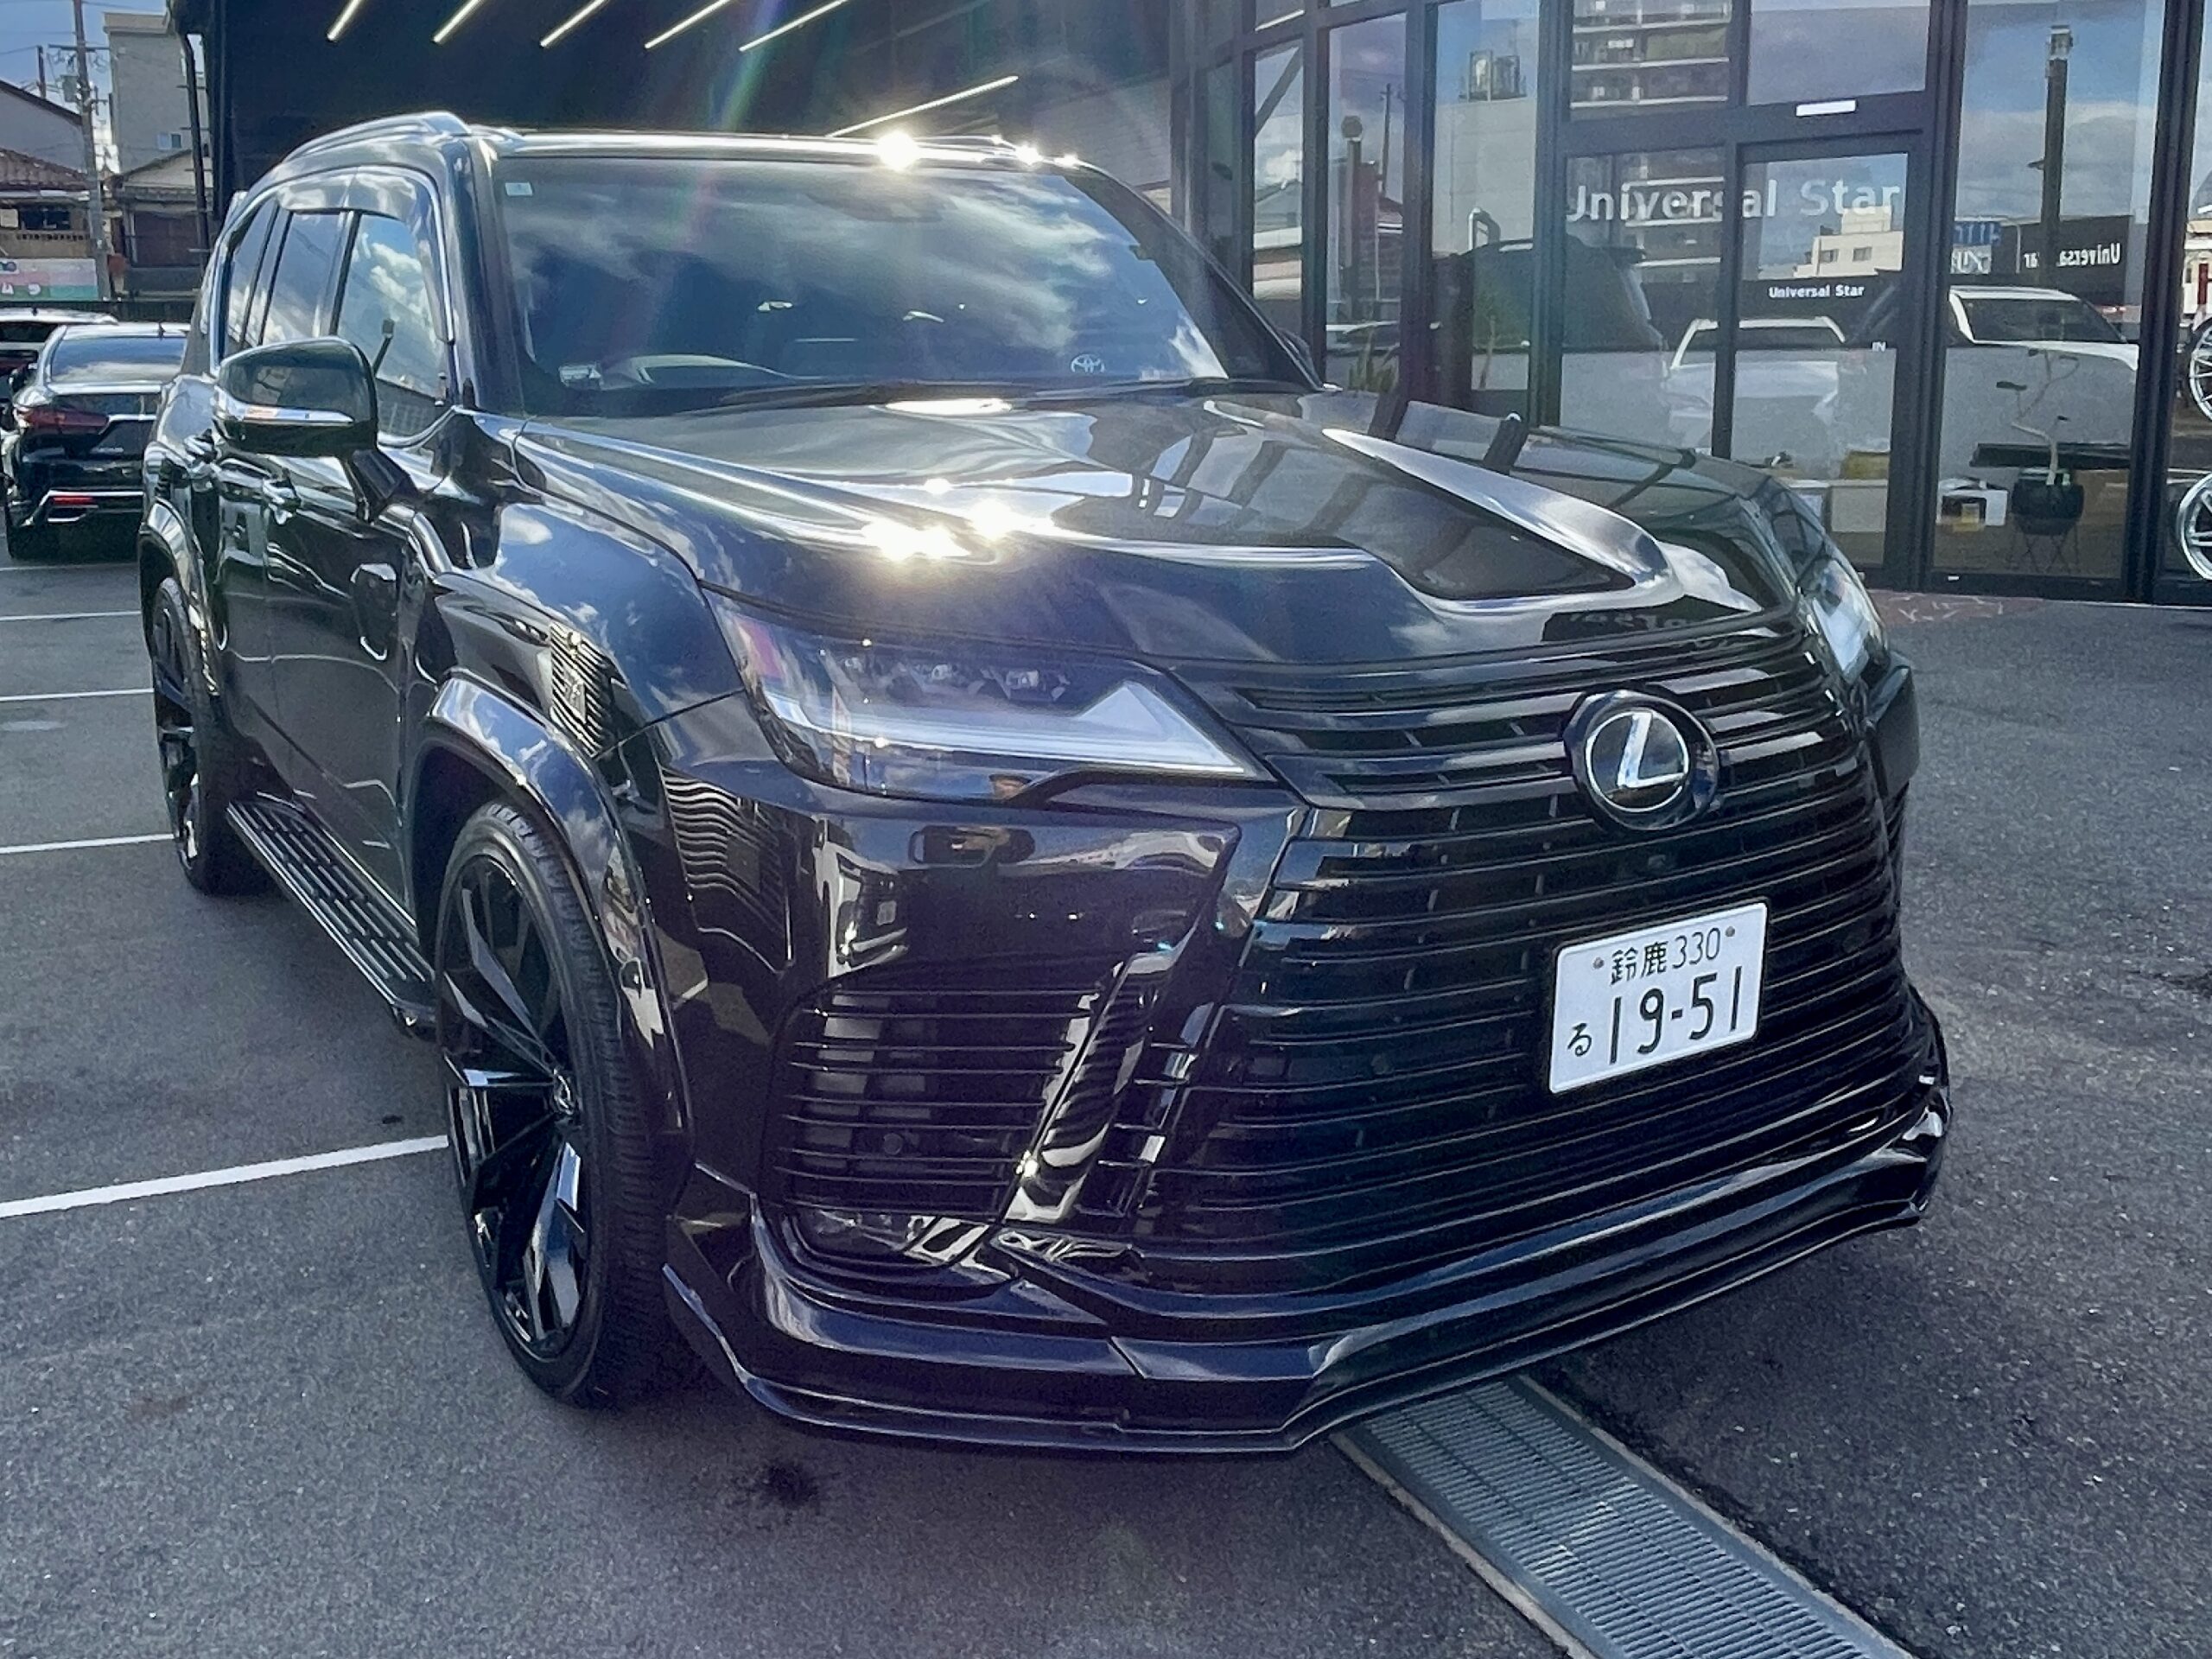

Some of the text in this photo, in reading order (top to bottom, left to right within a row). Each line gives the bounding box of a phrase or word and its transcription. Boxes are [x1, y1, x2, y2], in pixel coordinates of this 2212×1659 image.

[1800, 178, 1901, 217] Star
[1768, 283, 1866, 298] Universal Star
[1567, 965, 1743, 1065] る 19-51
